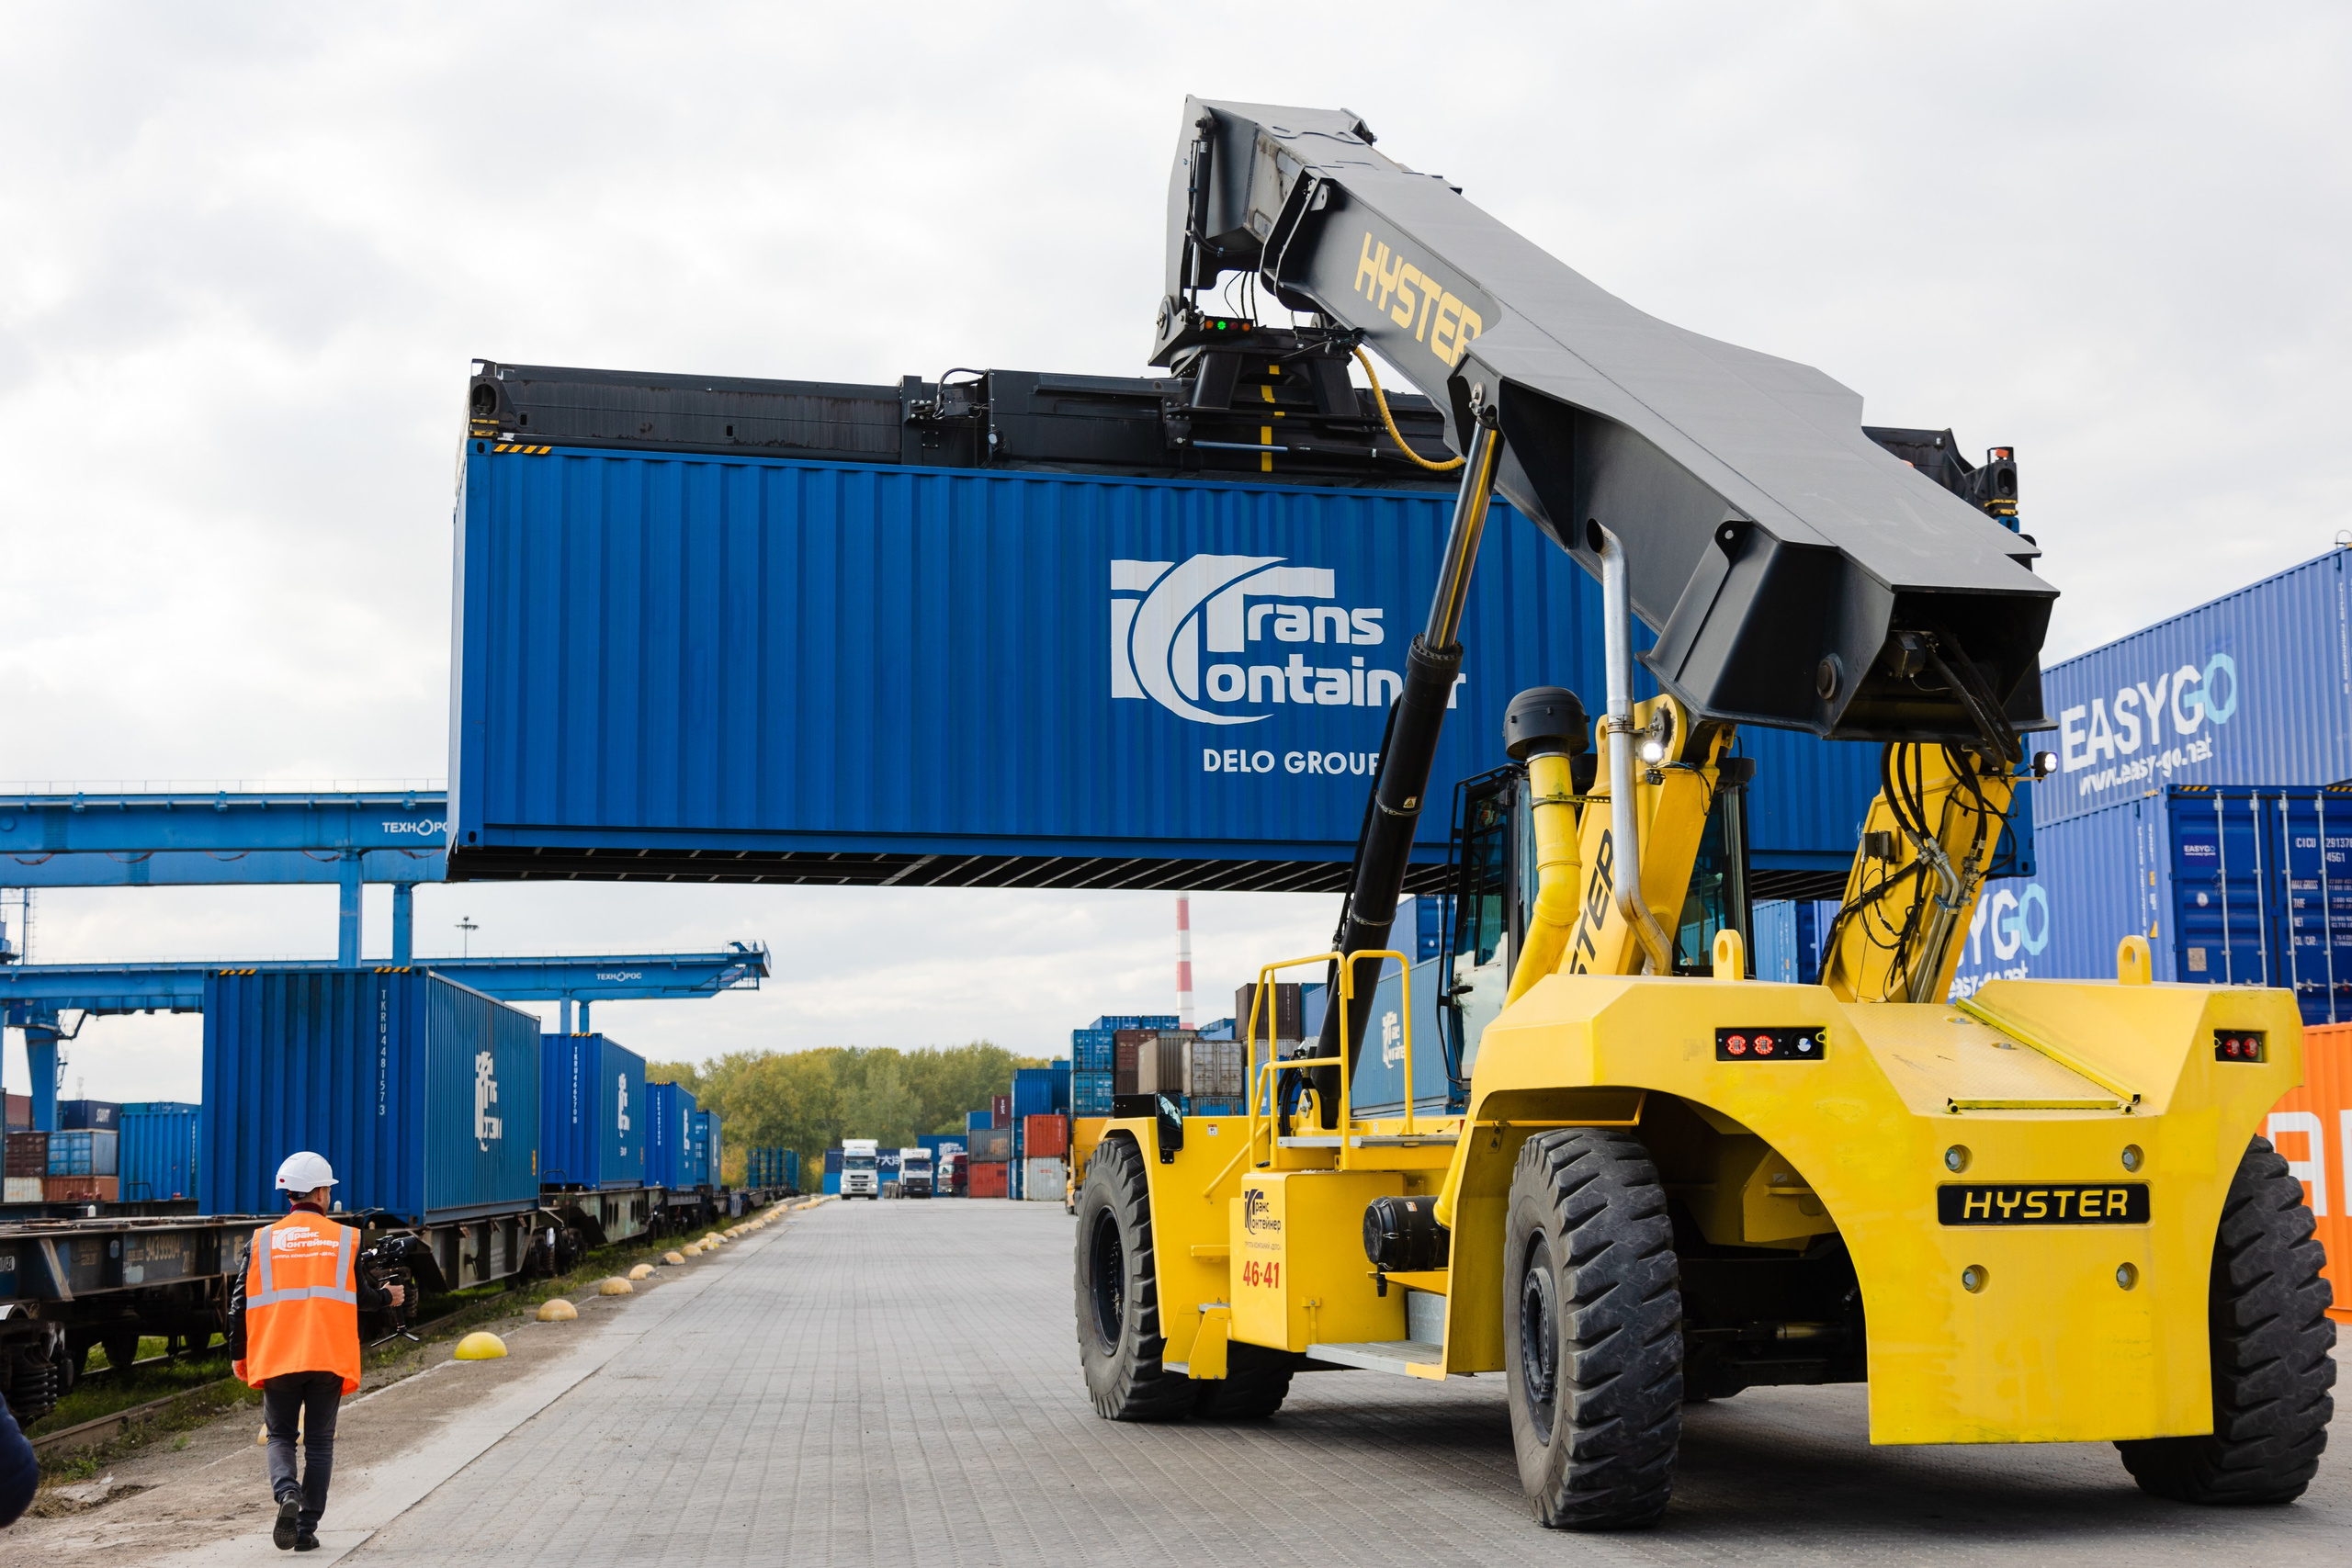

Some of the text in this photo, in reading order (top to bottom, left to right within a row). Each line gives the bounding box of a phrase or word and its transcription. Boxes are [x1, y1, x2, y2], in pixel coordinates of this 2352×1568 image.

[1354, 231, 1483, 368] HYSTER
[2060, 653, 2237, 773] EASYGO
[1204, 749, 1275, 773] DELO
[1957, 883, 2049, 966] YGO
[1963, 1190, 2129, 1219] HYSTER
